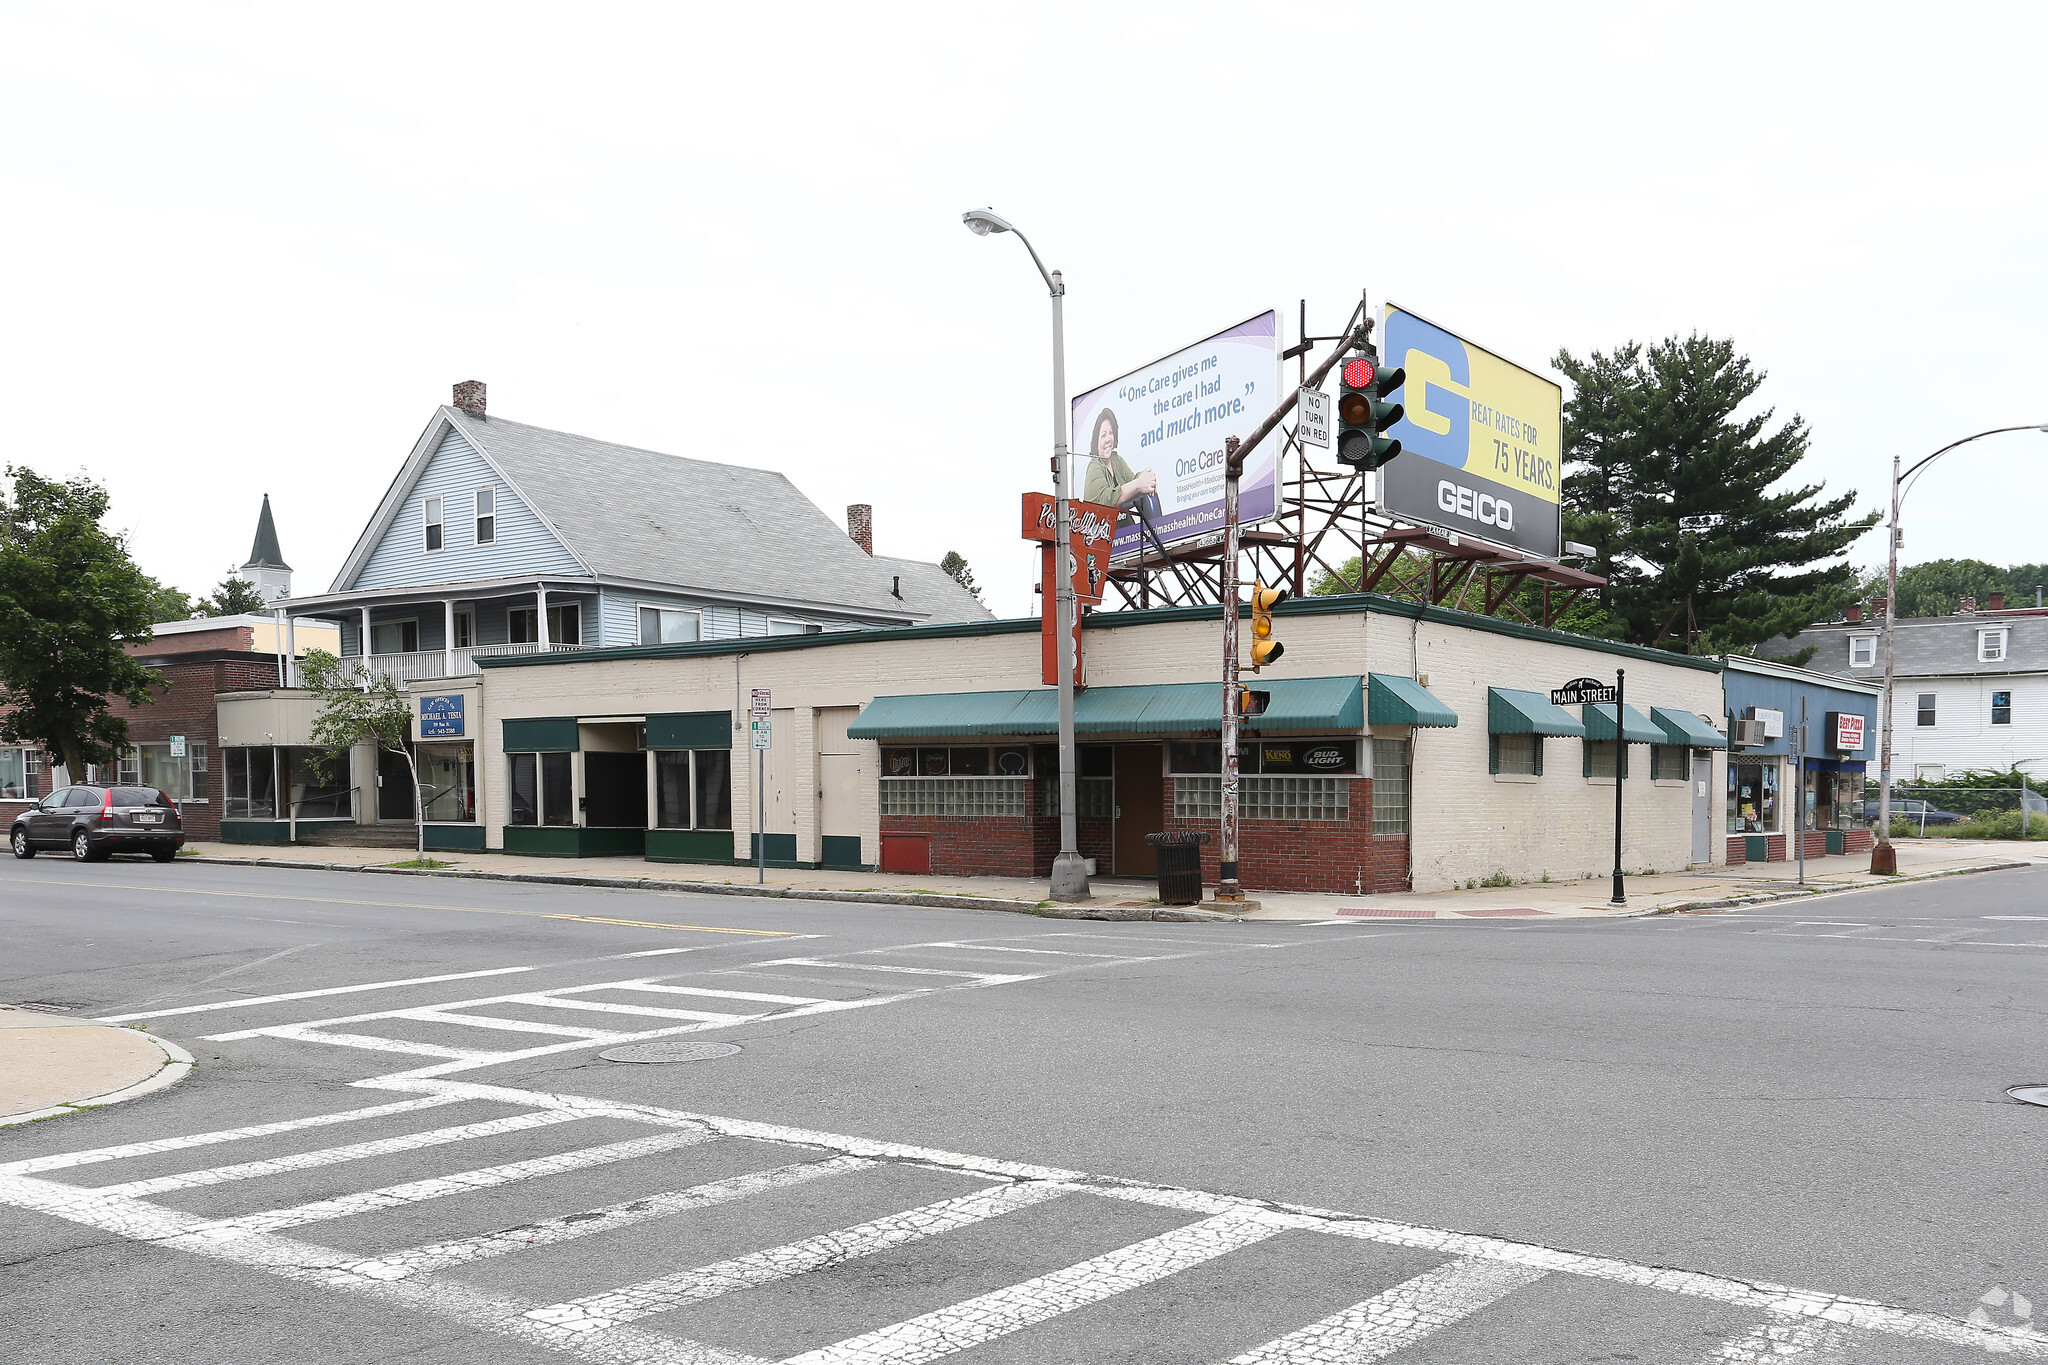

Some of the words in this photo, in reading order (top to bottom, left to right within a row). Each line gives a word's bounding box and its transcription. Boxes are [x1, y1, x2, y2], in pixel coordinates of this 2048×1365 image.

[1148, 375, 1170, 394] Care
[1172, 362, 1199, 388] gives
[1201, 355, 1218, 373] me
[1152, 398, 1170, 416] the
[1171, 390, 1193, 409] care
[1195, 384, 1198, 400] I
[1200, 374, 1221, 398] had
[1308, 396, 1321, 409] NO
[1140, 420, 1164, 448] and
[1166, 406, 1201, 438] much
[1304, 410, 1324, 425] TURN
[1496, 411, 1521, 439] RATES
[1523, 423, 1538, 447] FOR
[1300, 424, 1311, 437] ON
[1313, 428, 1328, 441] RED
[1175, 458, 1197, 477] One
[1198, 449, 1224, 470] Care
[1493, 438, 1509, 473] 75
[1513, 446, 1555, 491] YEARS.
[1176, 492, 1192, 503] Bringing
[1191, 490, 1199, 501] your
[1199, 487, 1208, 496] care
[1437, 479, 1514, 531] GEICO
[1038, 502, 1056, 530] Po
[1553, 690, 1578, 704] MAIN
[1580, 688, 1614, 702] STREET
[421, 712, 442, 720] MICHAEL
[448, 712, 462, 720] TESTA
[1308, 756, 1344, 764] LIGHT
